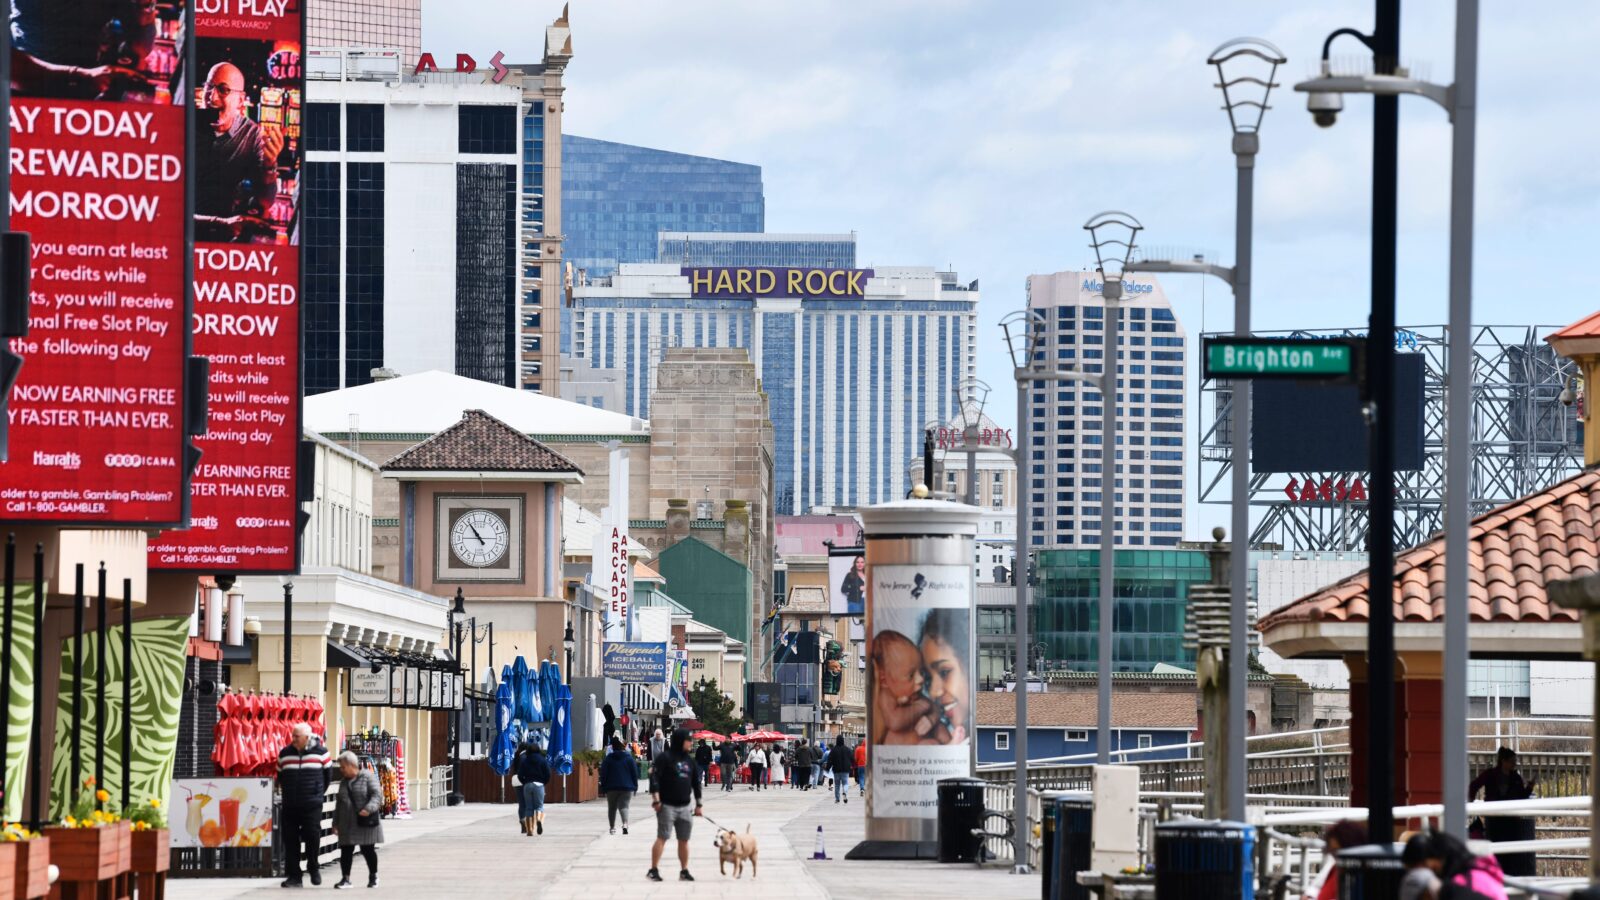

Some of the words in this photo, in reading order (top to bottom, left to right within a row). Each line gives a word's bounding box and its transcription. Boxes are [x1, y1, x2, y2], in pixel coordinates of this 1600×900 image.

[238, 0, 288, 17] PLAY
[49, 107, 158, 144] TODAY,
[10, 148, 181, 181] REWARDED
[32, 243, 63, 258] you
[67, 243, 107, 257] earn
[108, 244, 126, 258] at
[131, 242, 168, 259] least
[194, 248, 278, 276] TODAY,
[42, 264, 100, 281] Credits
[105, 267, 146, 283] while
[693, 269, 776, 294] HARD
[787, 270, 863, 295] ROCK
[1121, 280, 1153, 293] Palace
[55, 293, 84, 309] you
[88, 291, 116, 306] will
[121, 293, 173, 309] receive
[193, 281, 296, 306] WARDED
[64, 314, 98, 330] Free
[102, 315, 132, 331] Slot
[136, 316, 168, 337] Play
[9, 338, 37, 354] the
[43, 338, 118, 359] following
[208, 354, 237, 364] earn
[240, 353, 254, 365] at
[257, 352, 285, 365] least
[1224, 345, 1314, 373] Brighton
[1322, 347, 1343, 359] Ave
[208, 371, 234, 383] dits
[237, 372, 269, 384] while
[13, 385, 58, 401] NOW
[62, 386, 137, 404] EARNING
[140, 388, 176, 405] FREE
[224, 391, 245, 403] will
[249, 392, 290, 405] receive
[21, 409, 79, 426] FASTER
[82, 410, 128, 428] THAN
[132, 411, 174, 429] EVER.
[234, 408, 258, 422] Slot
[261, 409, 286, 427] Play
[104, 453, 176, 467] TROPICANA
[204, 465, 261, 479] EARNING
[263, 466, 291, 479] FREE
[0, 488, 26, 499] older
[28, 489, 40, 499] to
[41, 489, 81, 502] gamble.
[83, 489, 129, 503] Gambling
[131, 490, 173, 503] Problem?
[219, 484, 254, 497] THAN
[257, 485, 290, 498] EVER.
[6, 501, 25, 512] Call
[236, 517, 291, 528] TROPICANA
[157, 544, 176, 553] older
[178, 545, 186, 553] to
[188, 545, 218, 556] gamble.
[220, 545, 255, 555] Gambling
[256, 546, 288, 555] Problem?
[161, 555, 176, 563] Call
[620, 535, 628, 617] ARCADE
[892, 581, 912, 591] Jersey
[928, 582, 946, 591] Right
[897, 757, 916, 766] baby
[882, 767, 912, 775] blossom
[913, 767, 922, 775] of
[883, 779, 915, 788] precious
